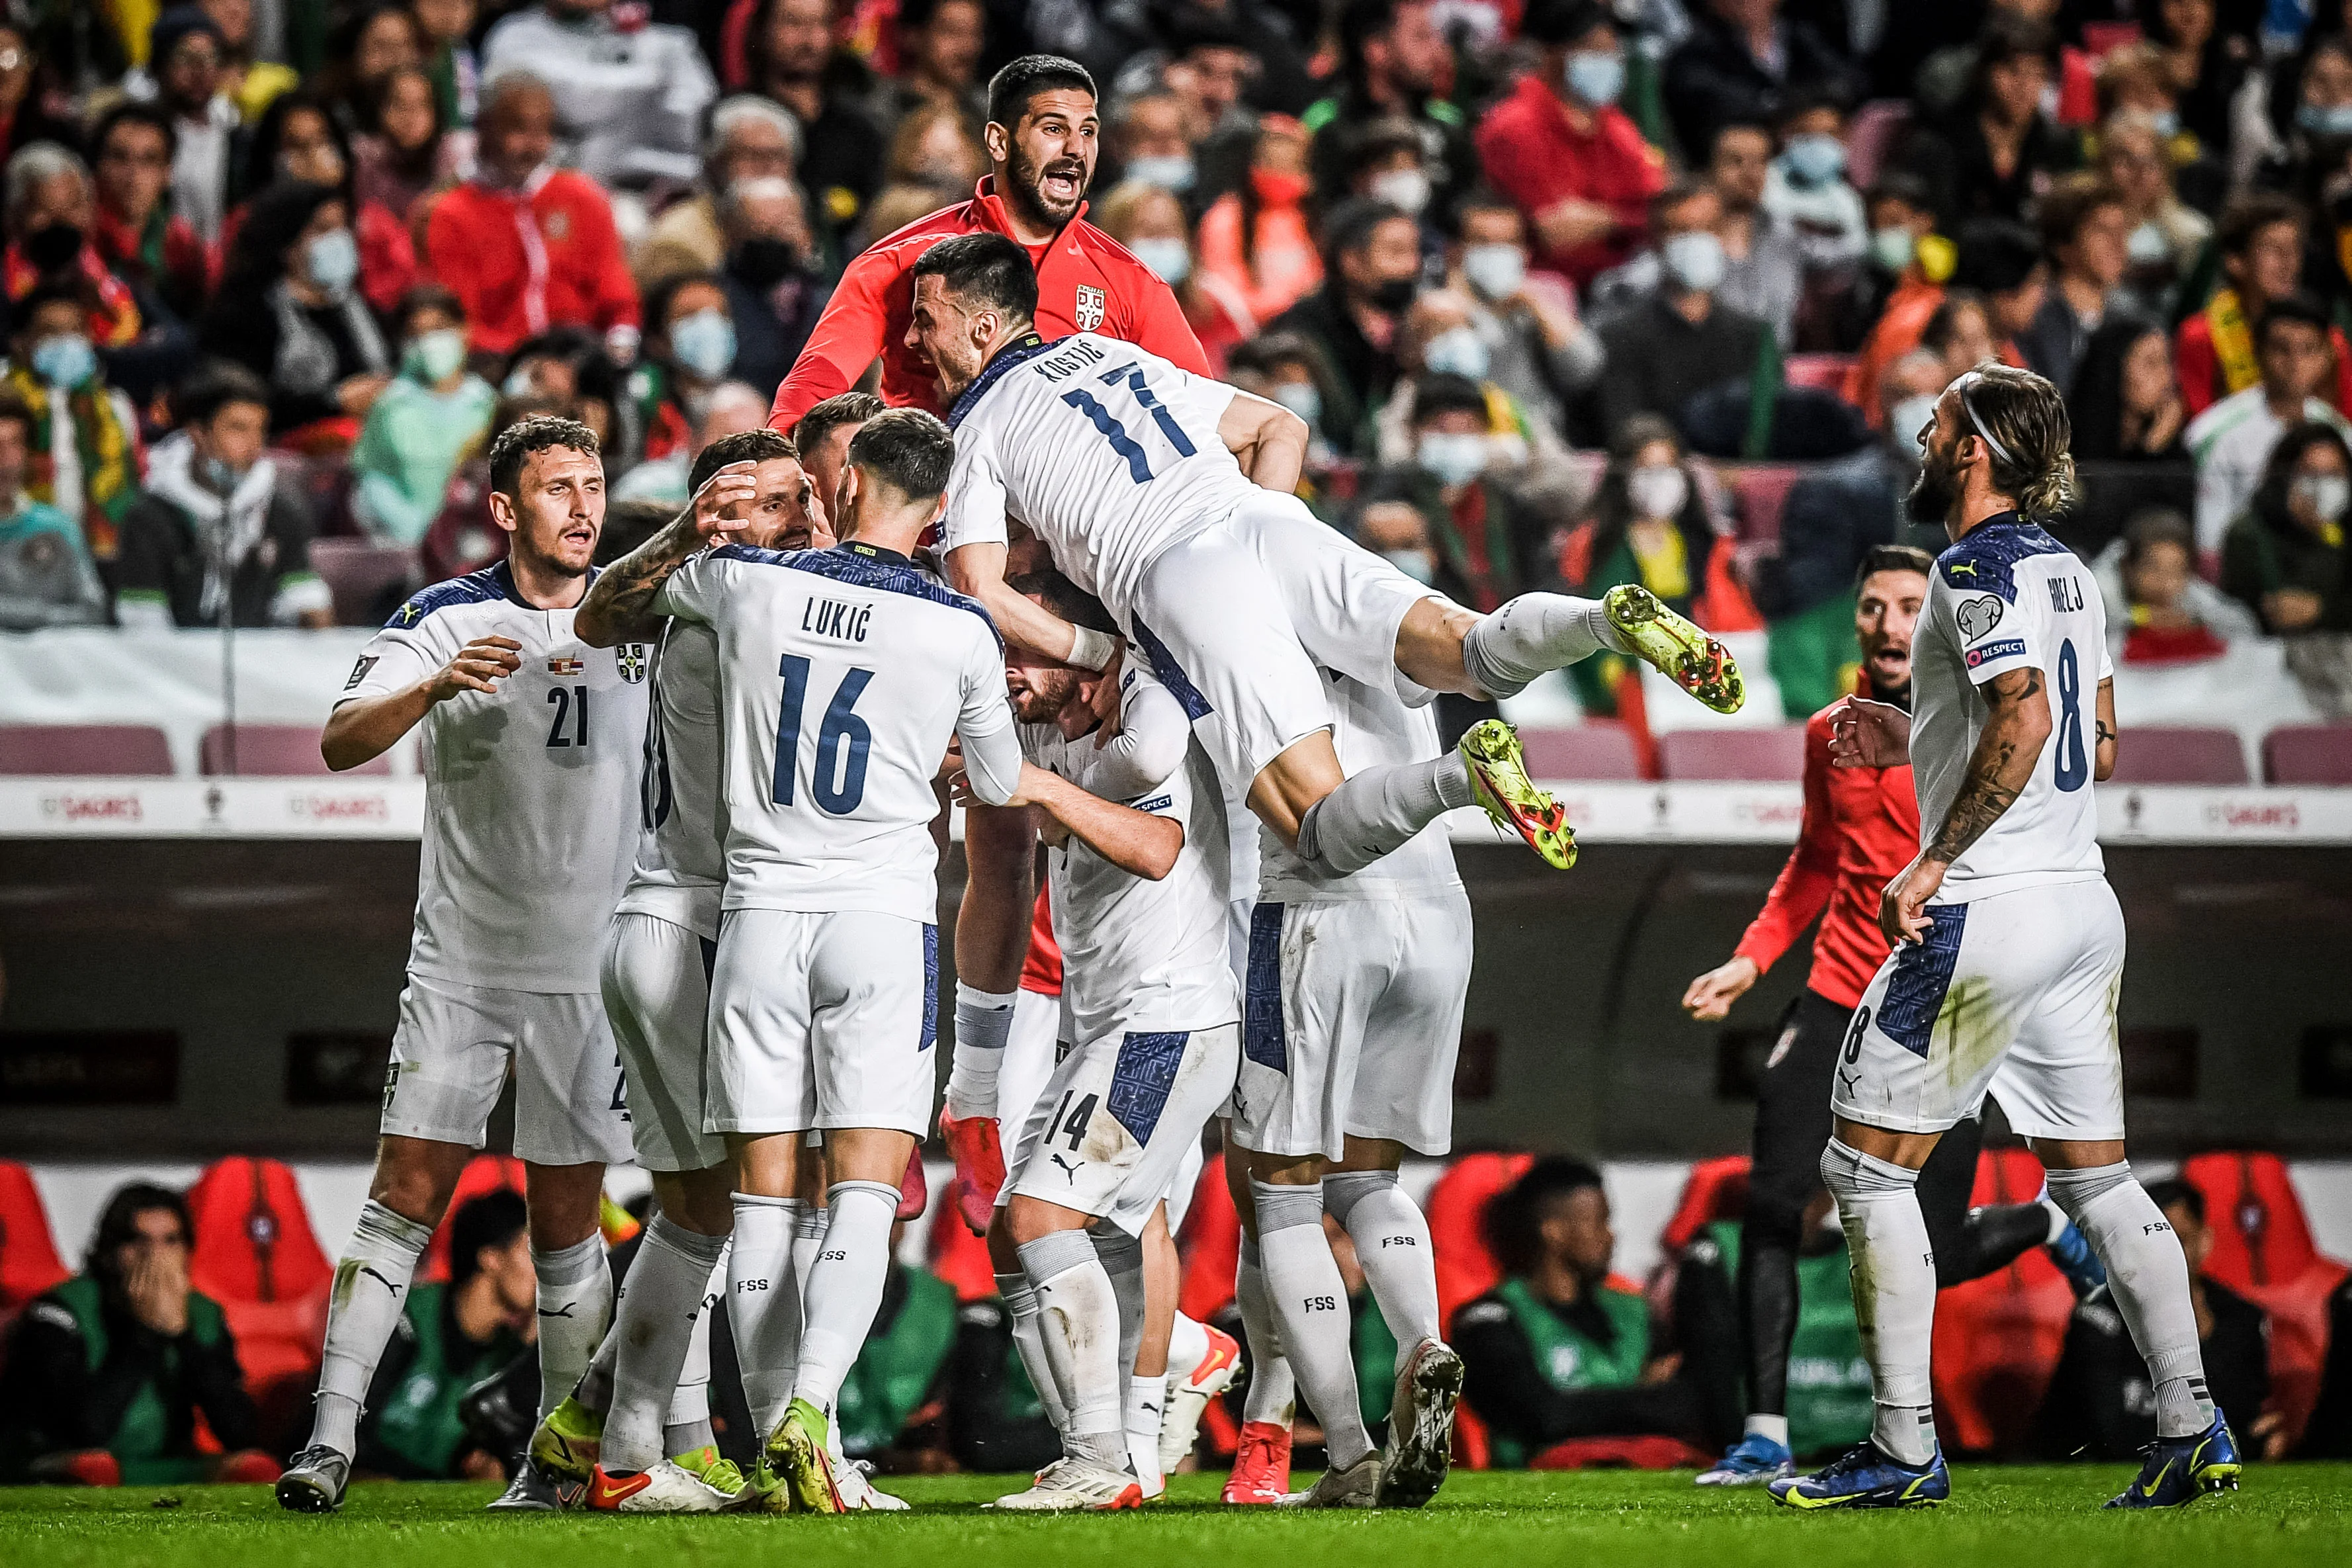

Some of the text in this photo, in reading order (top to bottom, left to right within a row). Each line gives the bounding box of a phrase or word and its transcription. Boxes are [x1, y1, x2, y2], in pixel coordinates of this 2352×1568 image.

[1033, 339, 1105, 382] KOSTIĆ
[1060, 361, 1198, 484] 17
[801, 597, 874, 642] LUKIĆ
[1982, 642, 2024, 659] RESPECT
[546, 685, 589, 748] 21
[772, 653, 876, 815] 16
[2054, 637, 2088, 793] 8
[1136, 797, 1170, 811] SPECT
[1845, 1005, 1871, 1065] 8
[1043, 1090, 1100, 1152] 14
[1382, 1236, 1416, 1248] FSS
[2142, 1222, 2171, 1236] FSS
[815, 1250, 846, 1264] FSS
[737, 1279, 769, 1294] FSS
[1303, 1295, 1336, 1314] FSS
